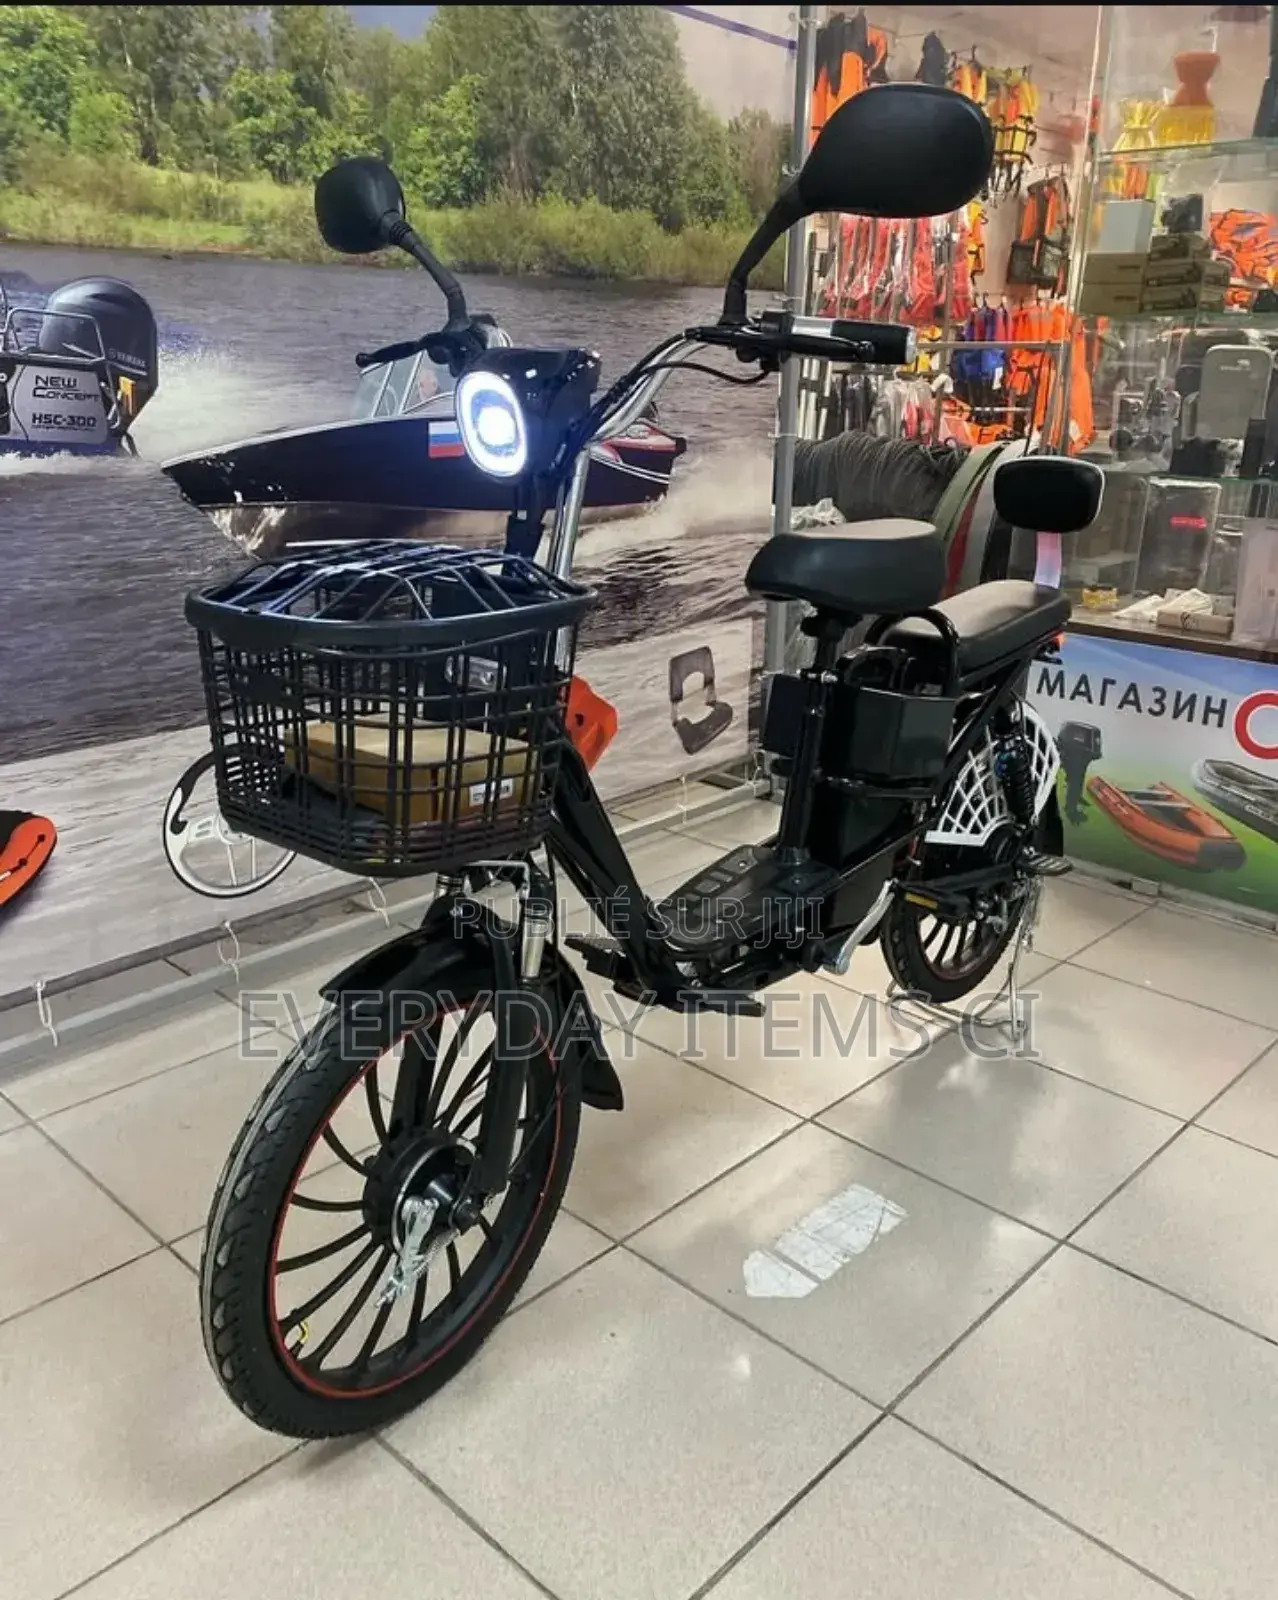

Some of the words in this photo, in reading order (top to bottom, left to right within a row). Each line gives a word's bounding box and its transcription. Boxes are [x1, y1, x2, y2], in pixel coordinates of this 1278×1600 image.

[35, 375, 78, 388] NEW
[32, 413, 97, 427] HSC-300
[1036, 667, 1228, 728] МАГАЗИН
